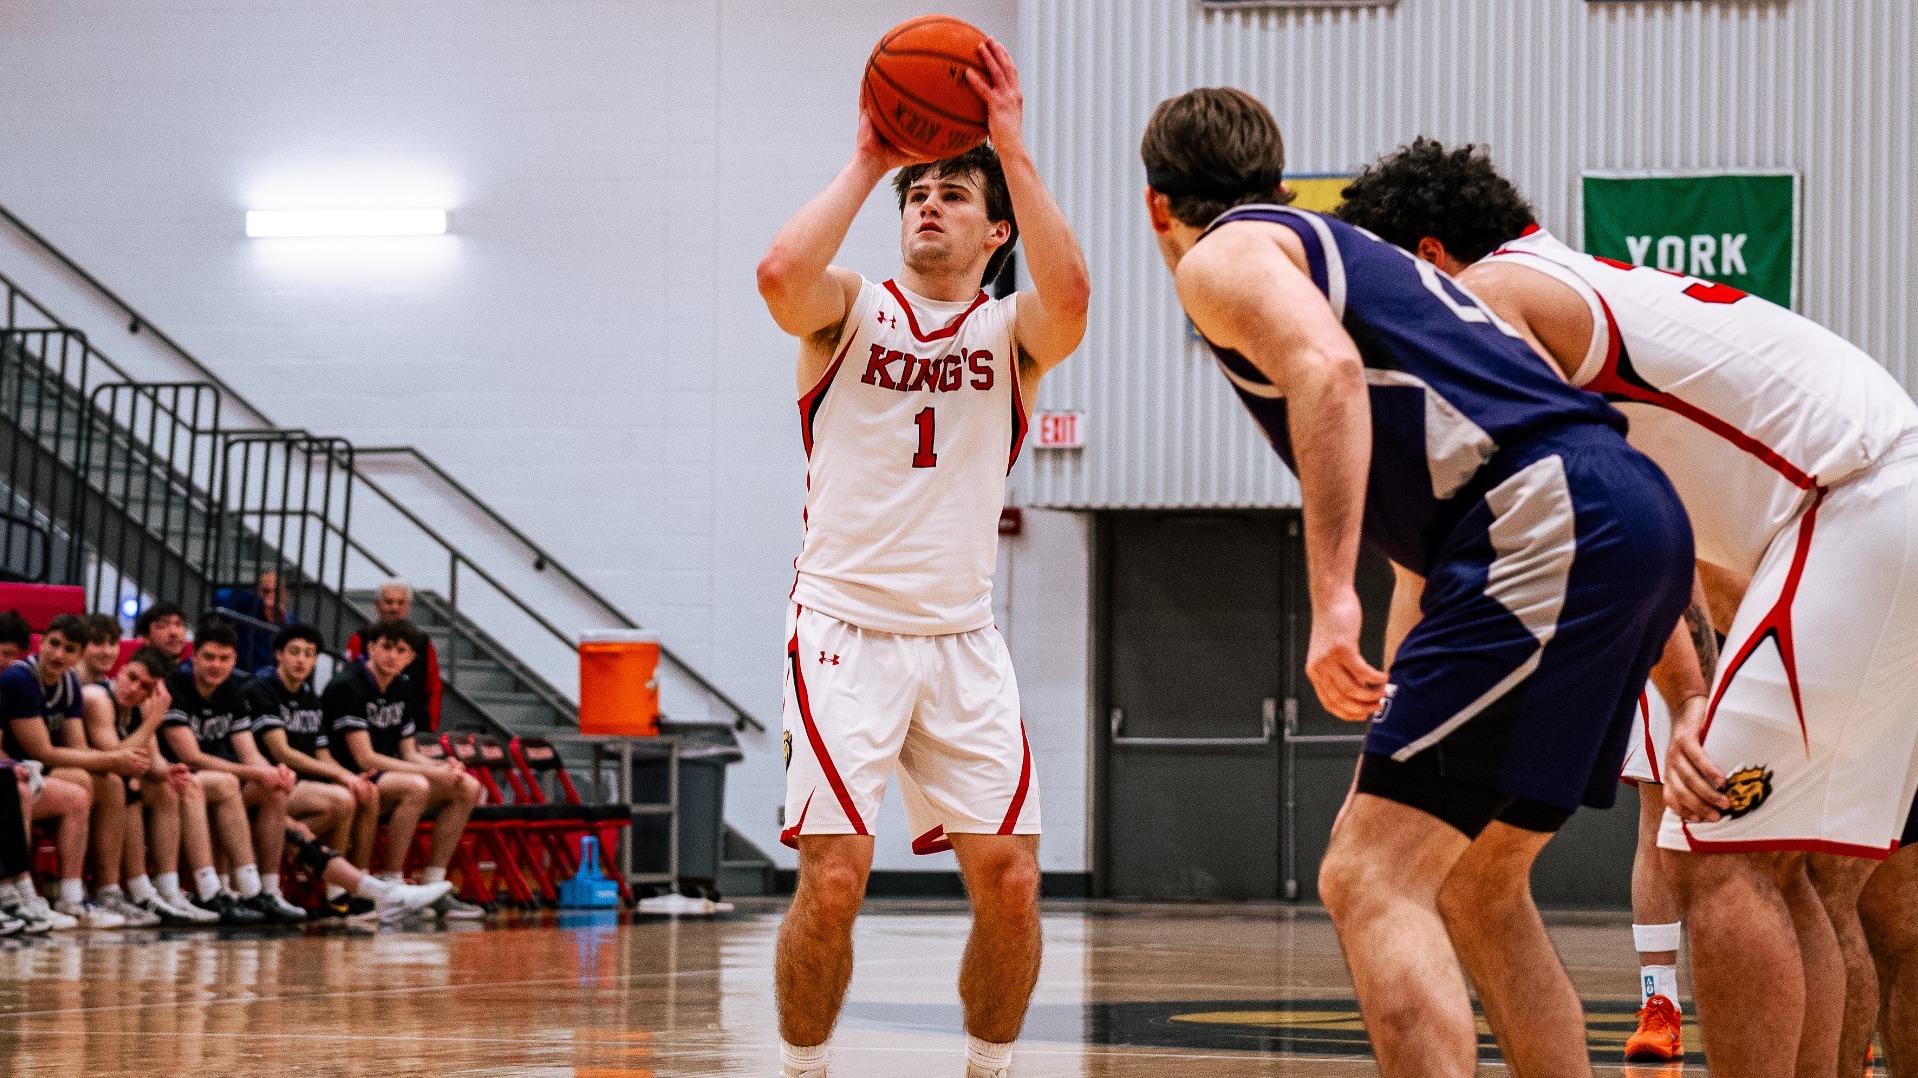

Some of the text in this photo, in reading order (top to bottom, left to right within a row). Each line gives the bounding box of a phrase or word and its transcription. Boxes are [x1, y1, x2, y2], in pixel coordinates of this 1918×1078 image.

[1625, 233, 1748, 276] YORK
[861, 343, 994, 393] KING'S
[912, 406, 938, 468] 1
[1039, 413, 1078, 446] EXIT
